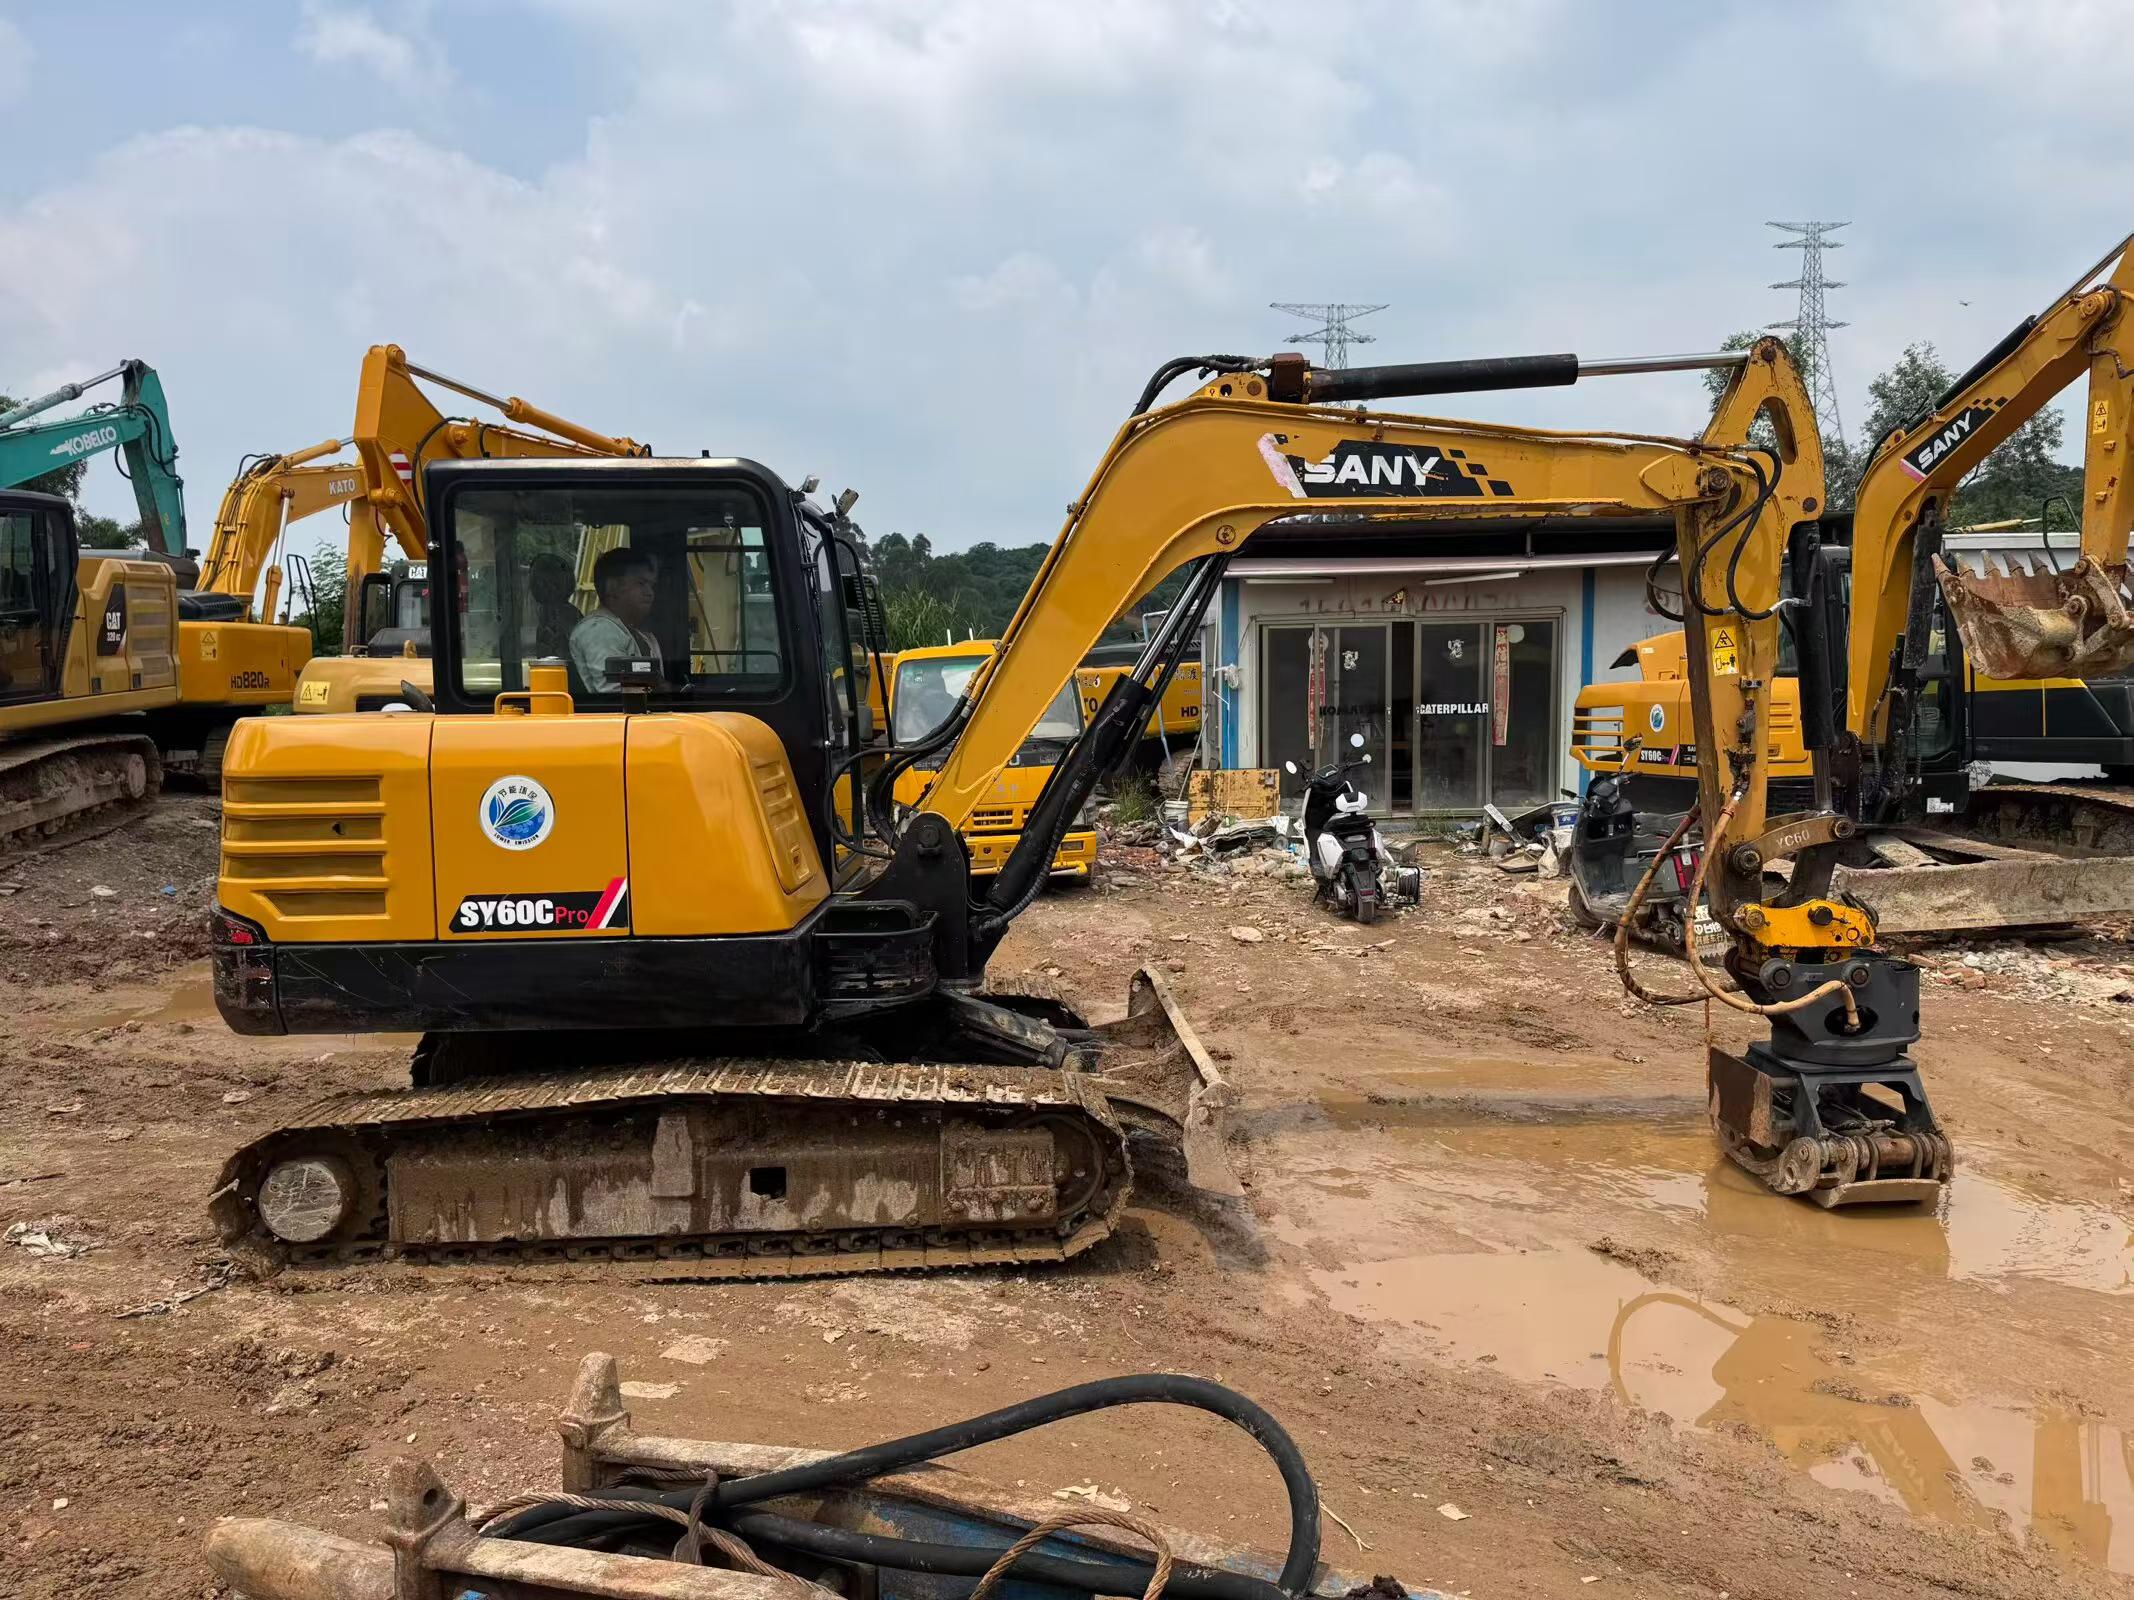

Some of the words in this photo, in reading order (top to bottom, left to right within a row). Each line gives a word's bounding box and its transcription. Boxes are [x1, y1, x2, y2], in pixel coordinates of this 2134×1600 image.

[65, 426, 117, 456] KOBELCO
[1918, 410, 1971, 470] SANY
[1304, 454, 1440, 486] SANY
[329, 478, 356, 496] KATO
[408, 566, 428, 579] CAT
[106, 612, 121, 630] CAT
[230, 671, 270, 689] HD820R
[1419, 703, 1489, 715] CATERPILLAR
[460, 900, 554, 927] SY60C
[555, 906, 589, 924] Pro
